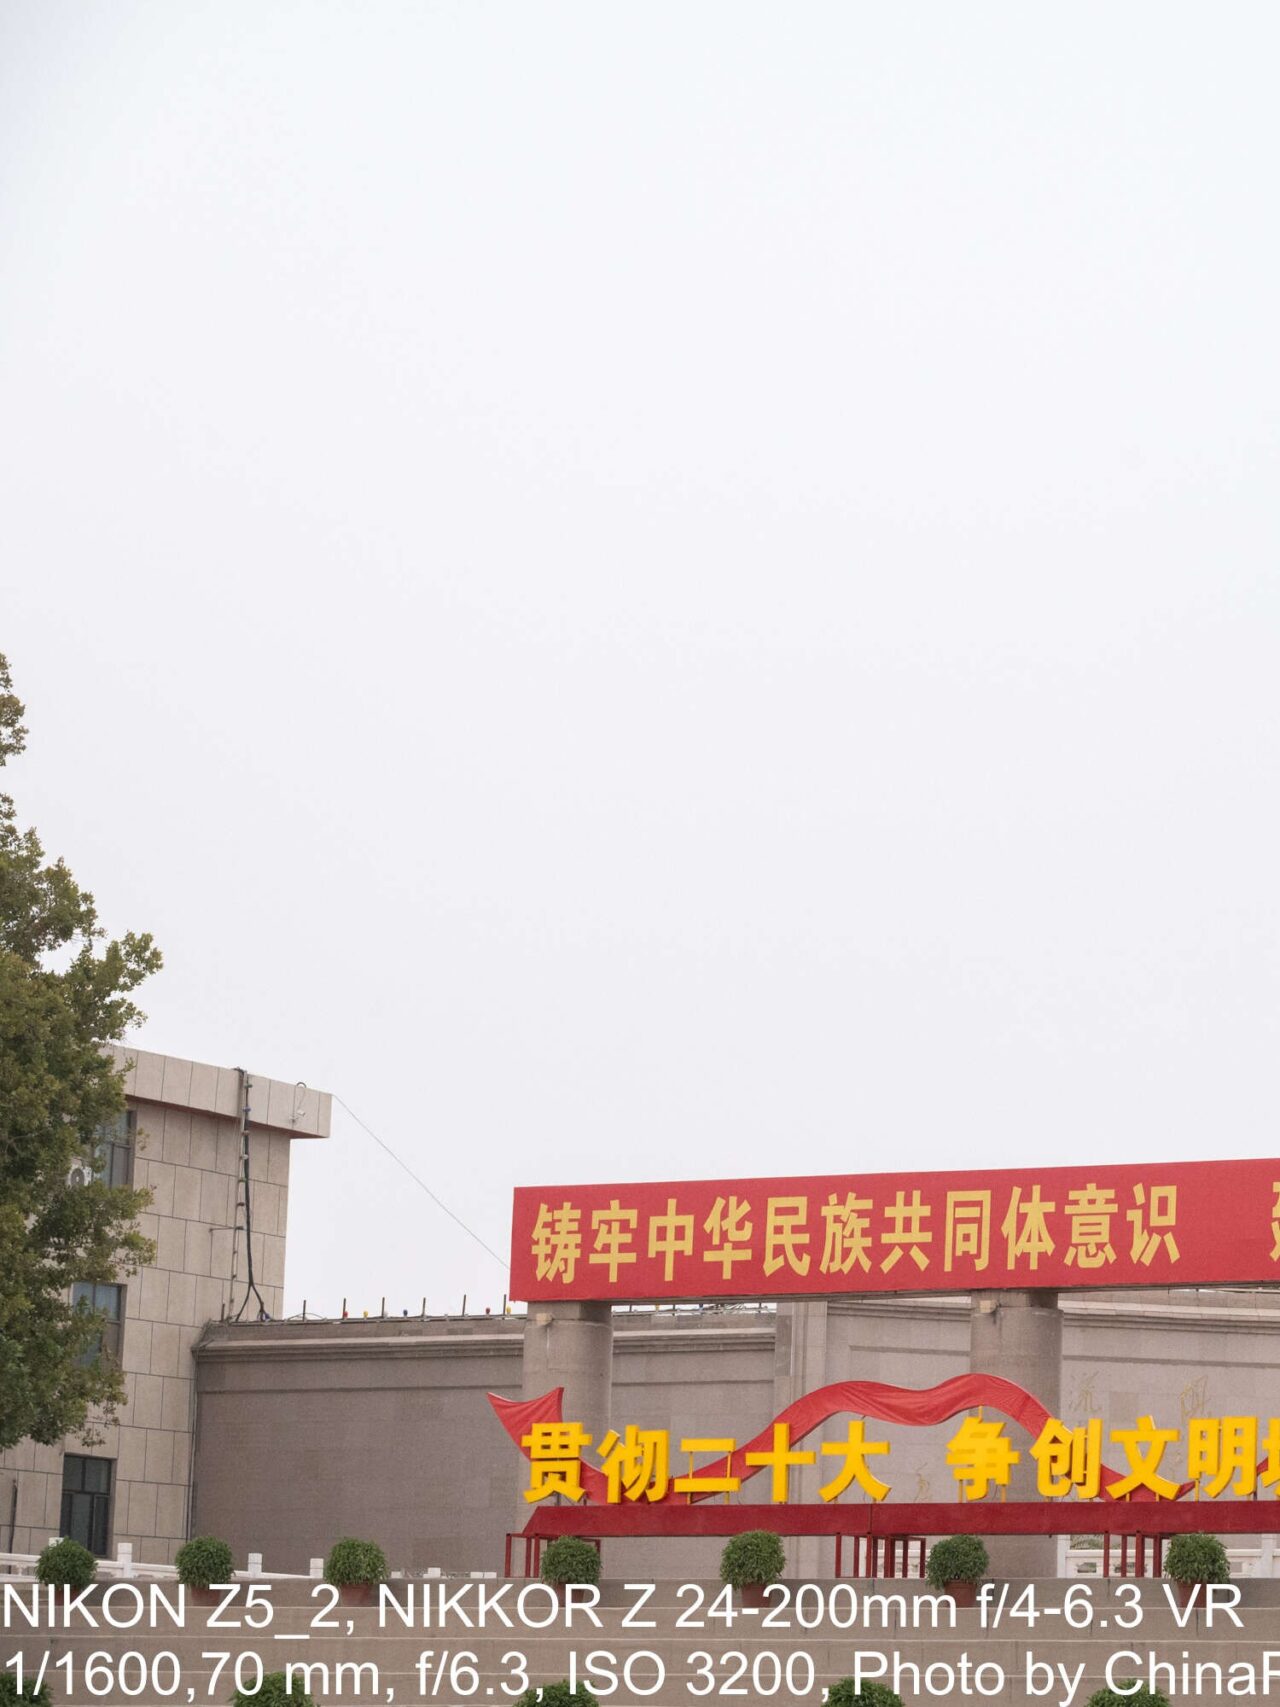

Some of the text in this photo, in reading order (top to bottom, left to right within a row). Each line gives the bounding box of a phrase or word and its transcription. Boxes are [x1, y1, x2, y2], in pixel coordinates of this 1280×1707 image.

[531, 1183, 1180, 1284] 铸牢中华民族共同体意识
[521, 1420, 892, 1504] 贯彻二十大
